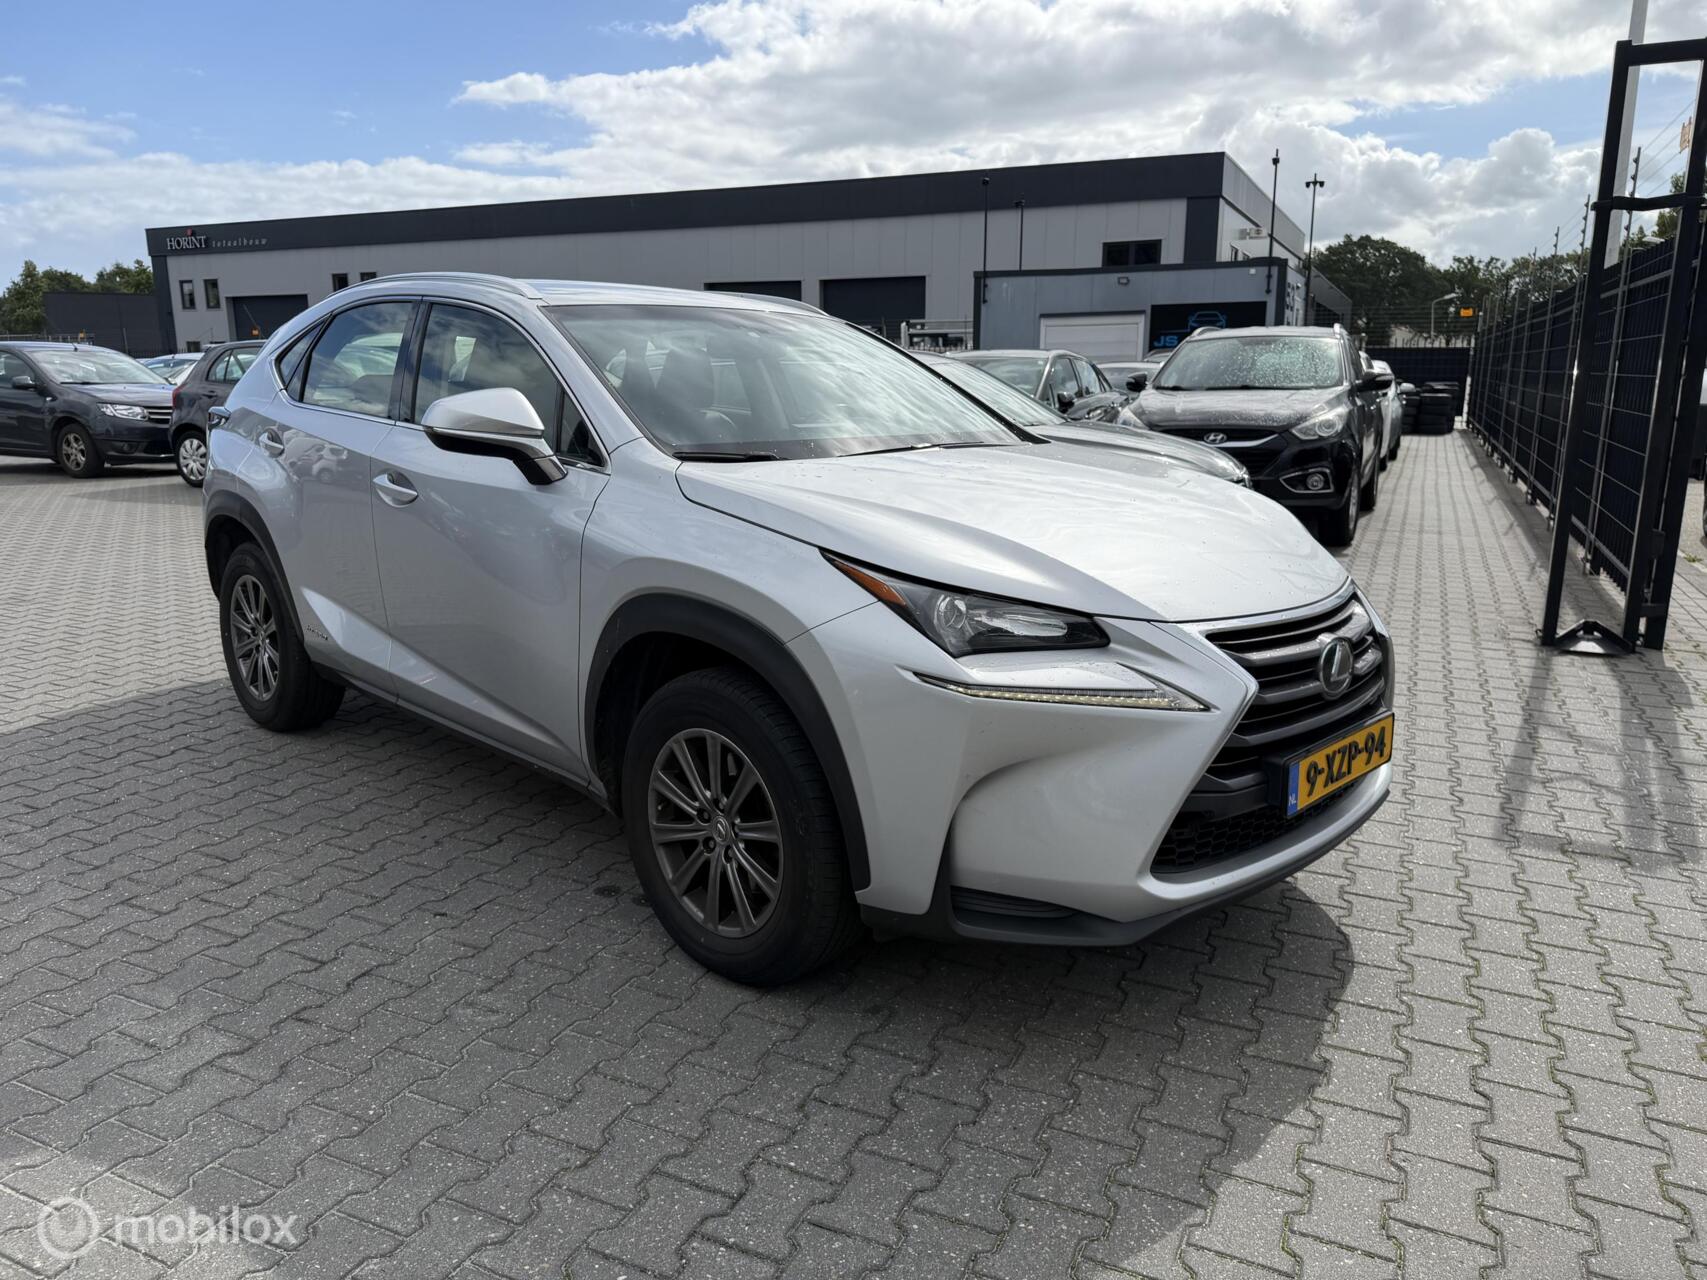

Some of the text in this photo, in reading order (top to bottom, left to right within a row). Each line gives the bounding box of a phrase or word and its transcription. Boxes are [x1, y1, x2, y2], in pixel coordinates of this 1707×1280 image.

[166, 235, 206, 250] HORINT
[1153, 335, 1178, 347] JS
[1306, 726, 1386, 798] 9-XZP-94
